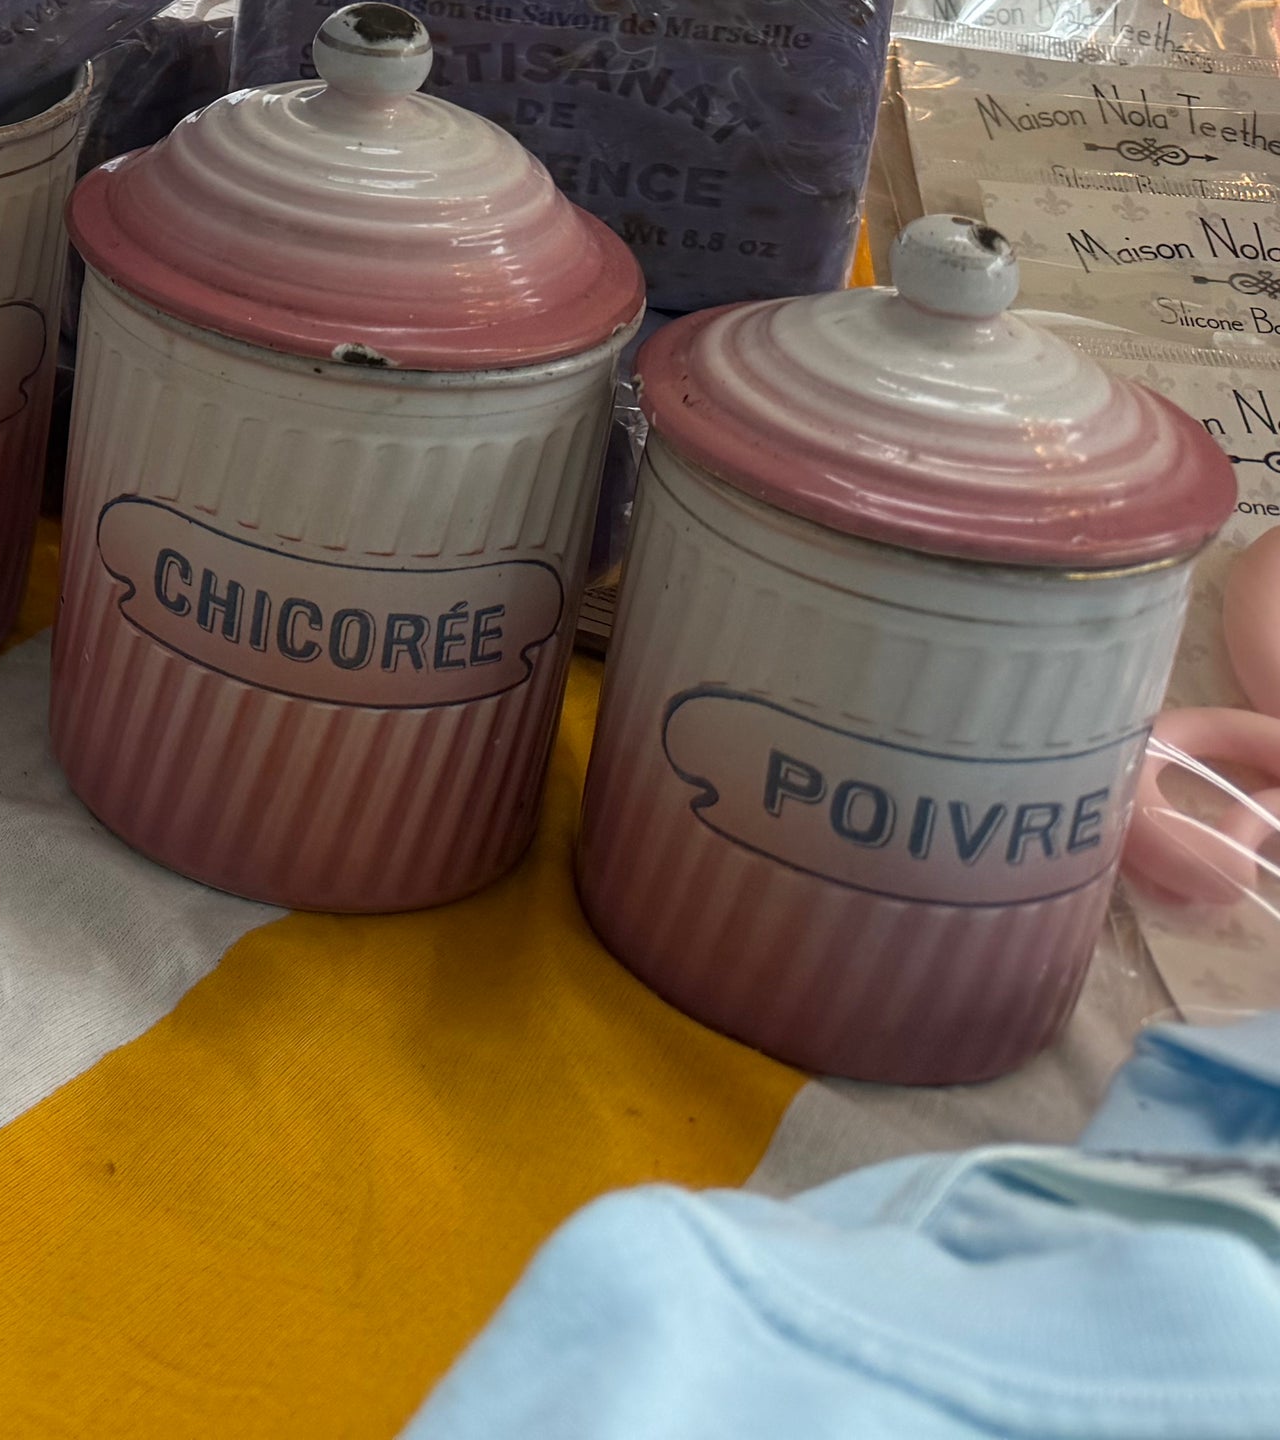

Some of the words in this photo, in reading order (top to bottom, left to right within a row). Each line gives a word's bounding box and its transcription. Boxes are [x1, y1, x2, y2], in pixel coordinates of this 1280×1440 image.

[521, 0, 611, 34] Savon
[619, 9, 658, 37] de
[514, 96, 578, 131] DE
[974, 93, 1088, 142] Maison
[546, 152, 730, 209] ENCE
[737, 237, 781, 259] oz
[1066, 229, 1195, 274] Maison
[1156, 296, 1246, 333] Silicone
[153, 546, 507, 674] CHICORÉE
[761, 746, 1112, 867] POIVRE
